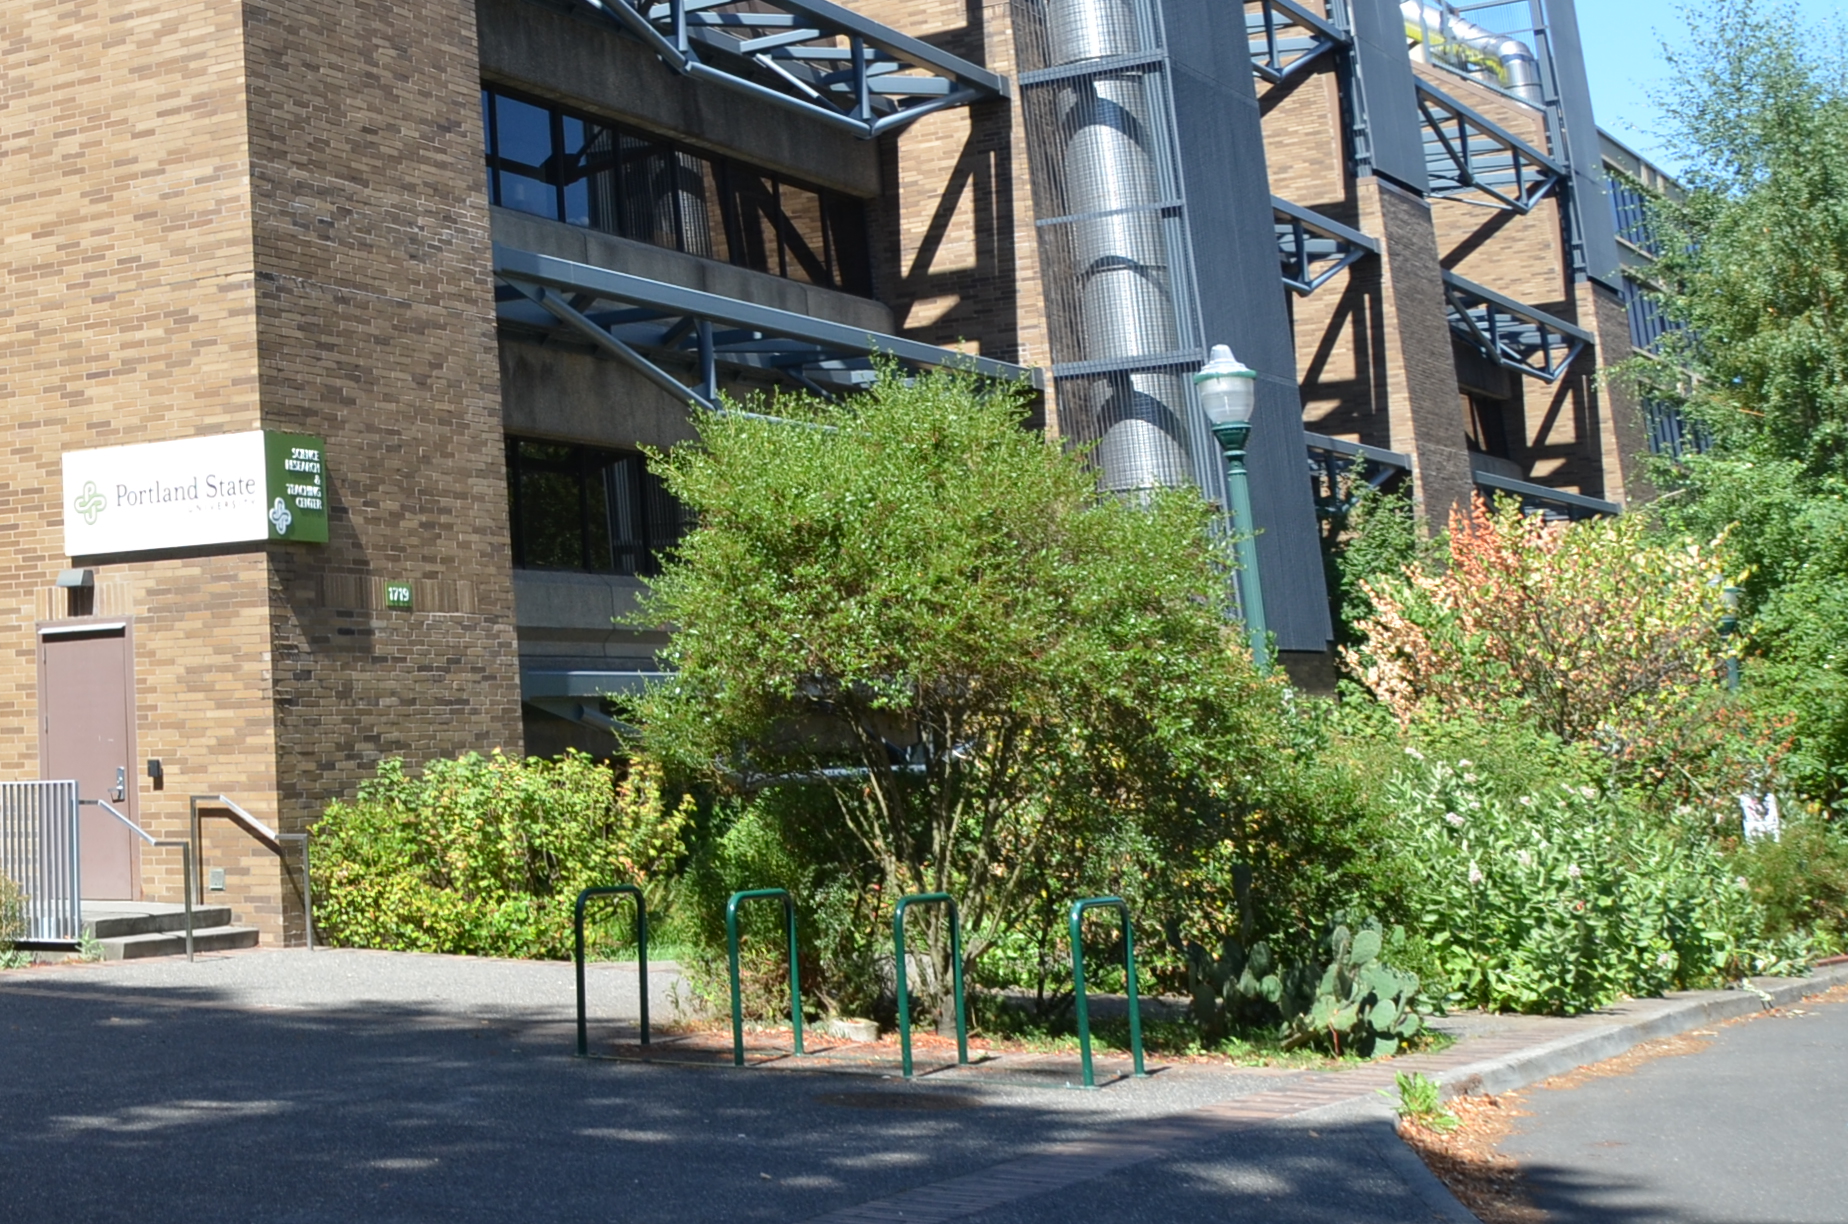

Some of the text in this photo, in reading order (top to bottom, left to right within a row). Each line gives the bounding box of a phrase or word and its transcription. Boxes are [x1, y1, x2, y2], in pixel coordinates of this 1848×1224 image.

[291, 447, 320, 461] SCIENCE
[285, 459, 320, 473] RESEARCH
[314, 474, 321, 485] &
[116, 474, 256, 507] Portland State
[285, 483, 322, 497] TEACHING
[295, 497, 322, 510] CENTER
[388, 587, 409, 601] 1719
